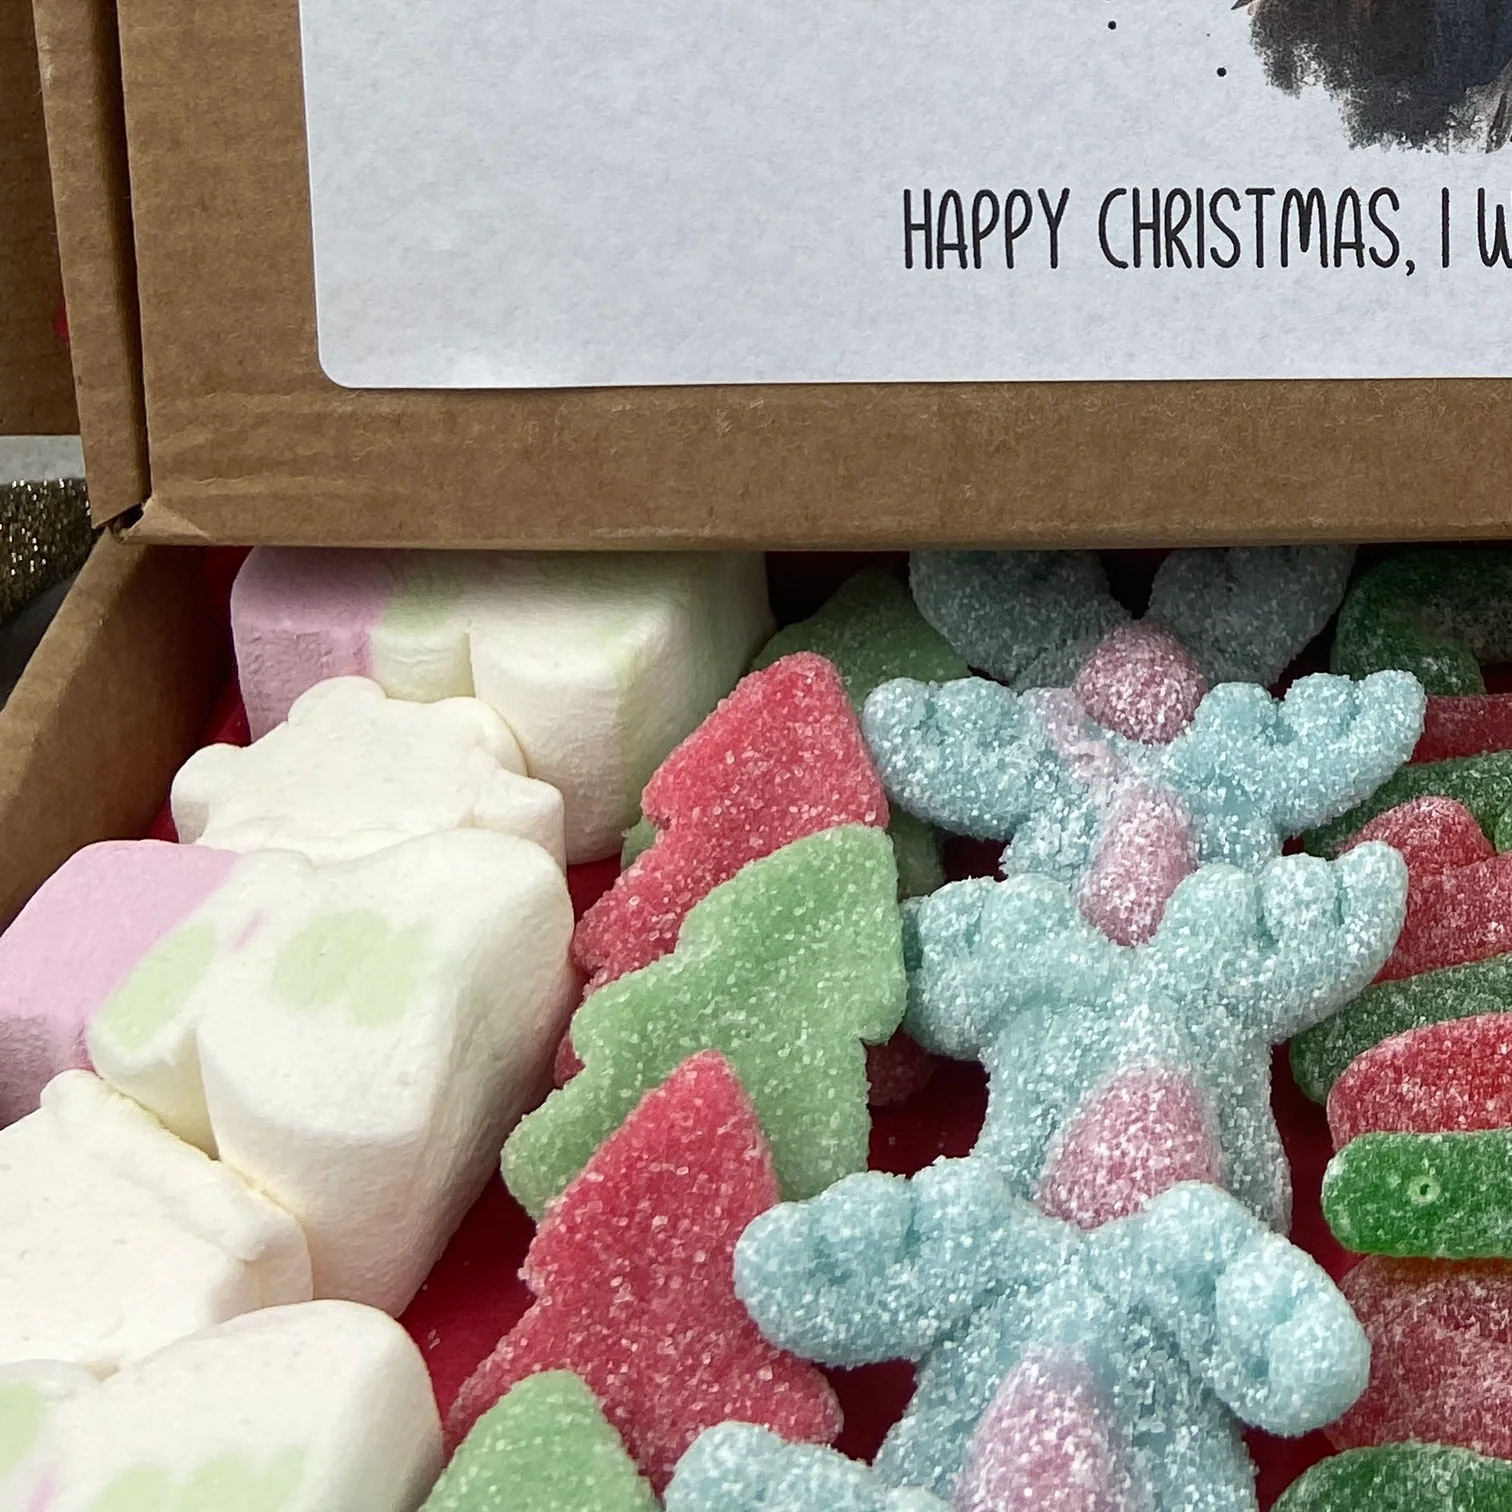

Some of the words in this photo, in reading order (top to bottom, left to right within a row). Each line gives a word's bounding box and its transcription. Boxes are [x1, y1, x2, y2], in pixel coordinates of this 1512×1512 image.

[903, 187, 1071, 270] HAPPY
[1098, 186, 1416, 277] CHRISTMAS,
[1440, 185, 1452, 269] I
